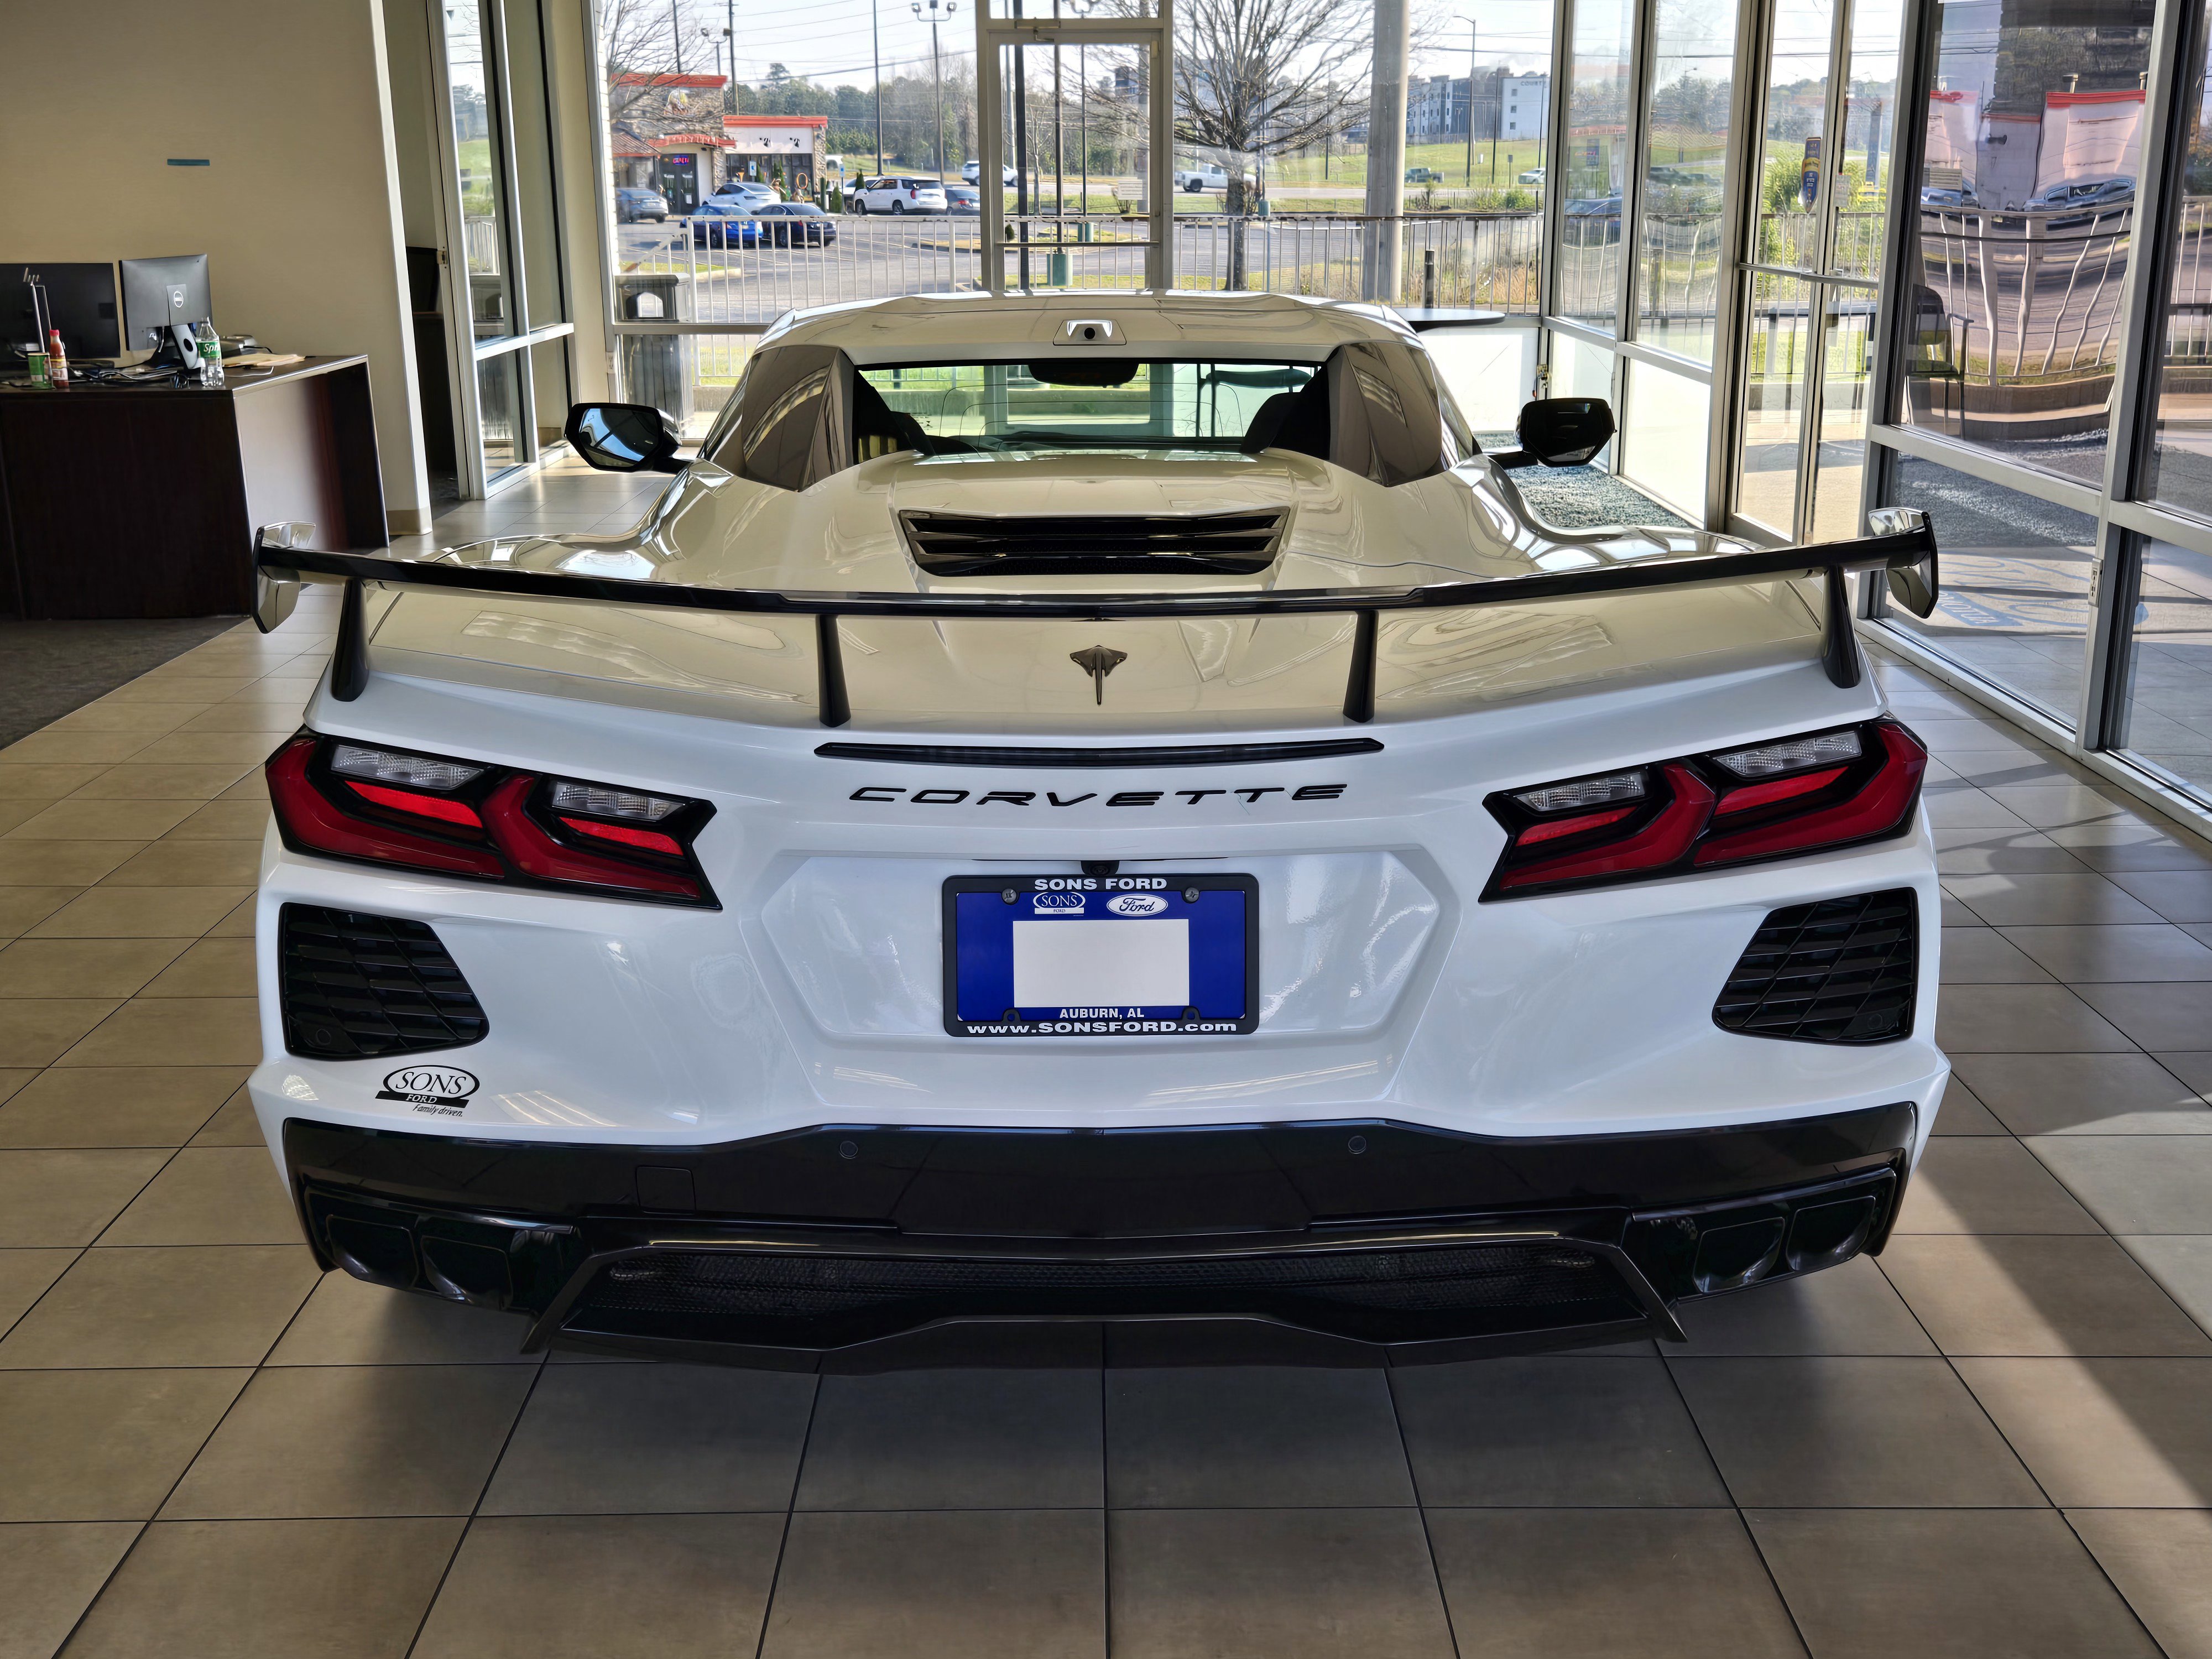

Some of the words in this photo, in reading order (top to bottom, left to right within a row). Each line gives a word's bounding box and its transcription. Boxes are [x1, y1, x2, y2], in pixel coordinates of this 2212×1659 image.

[849, 784, 1348, 807] CORVETTE
[1035, 879, 1097, 890] SONS
[1105, 878, 1167, 890] FORD
[1041, 895, 1077, 906] SONS
[1119, 898, 1155, 912] Ford
[1059, 1009, 1123, 1019] AUBURN,
[1127, 1008, 1145, 1018] AL
[967, 1021, 1237, 1034] www.SONSFORD.com
[395, 1071, 467, 1094] SONS
[405, 1094, 437, 1104] FORD
[412, 1103, 439, 1115] Family
[437, 1107, 463, 1117] driven.
